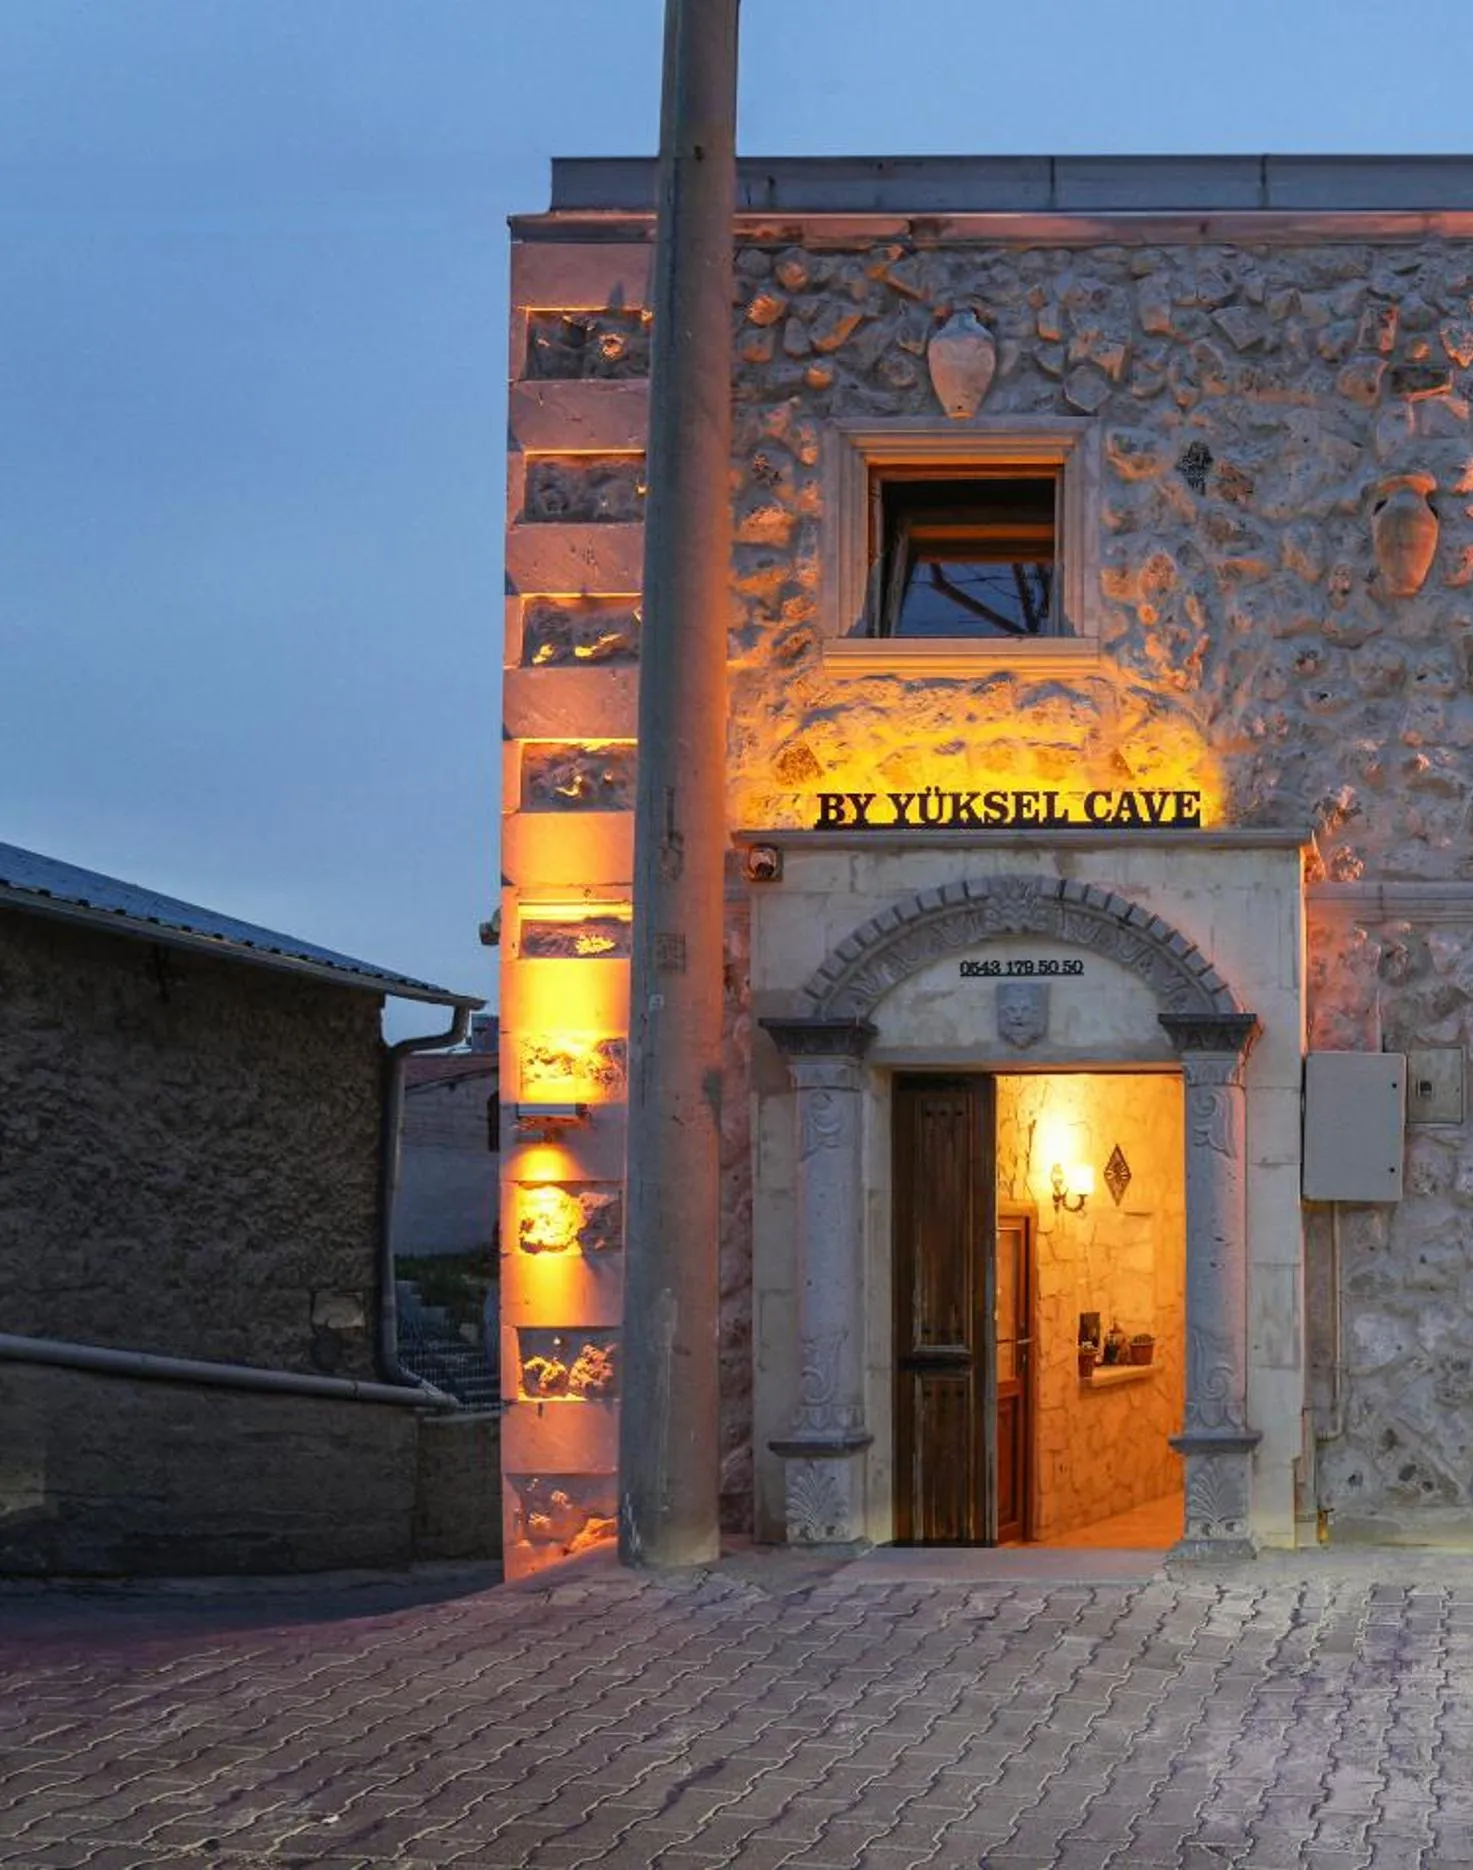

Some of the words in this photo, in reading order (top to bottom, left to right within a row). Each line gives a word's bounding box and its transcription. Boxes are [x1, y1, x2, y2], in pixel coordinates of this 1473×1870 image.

[816, 793, 876, 827] BY
[887, 786, 1069, 827] YÜKSEL
[1083, 791, 1201, 827] CAVE
[960, 960, 1000, 976] 0543
[1038, 960, 1060, 976] 50
[1062, 960, 1084, 976] 50
